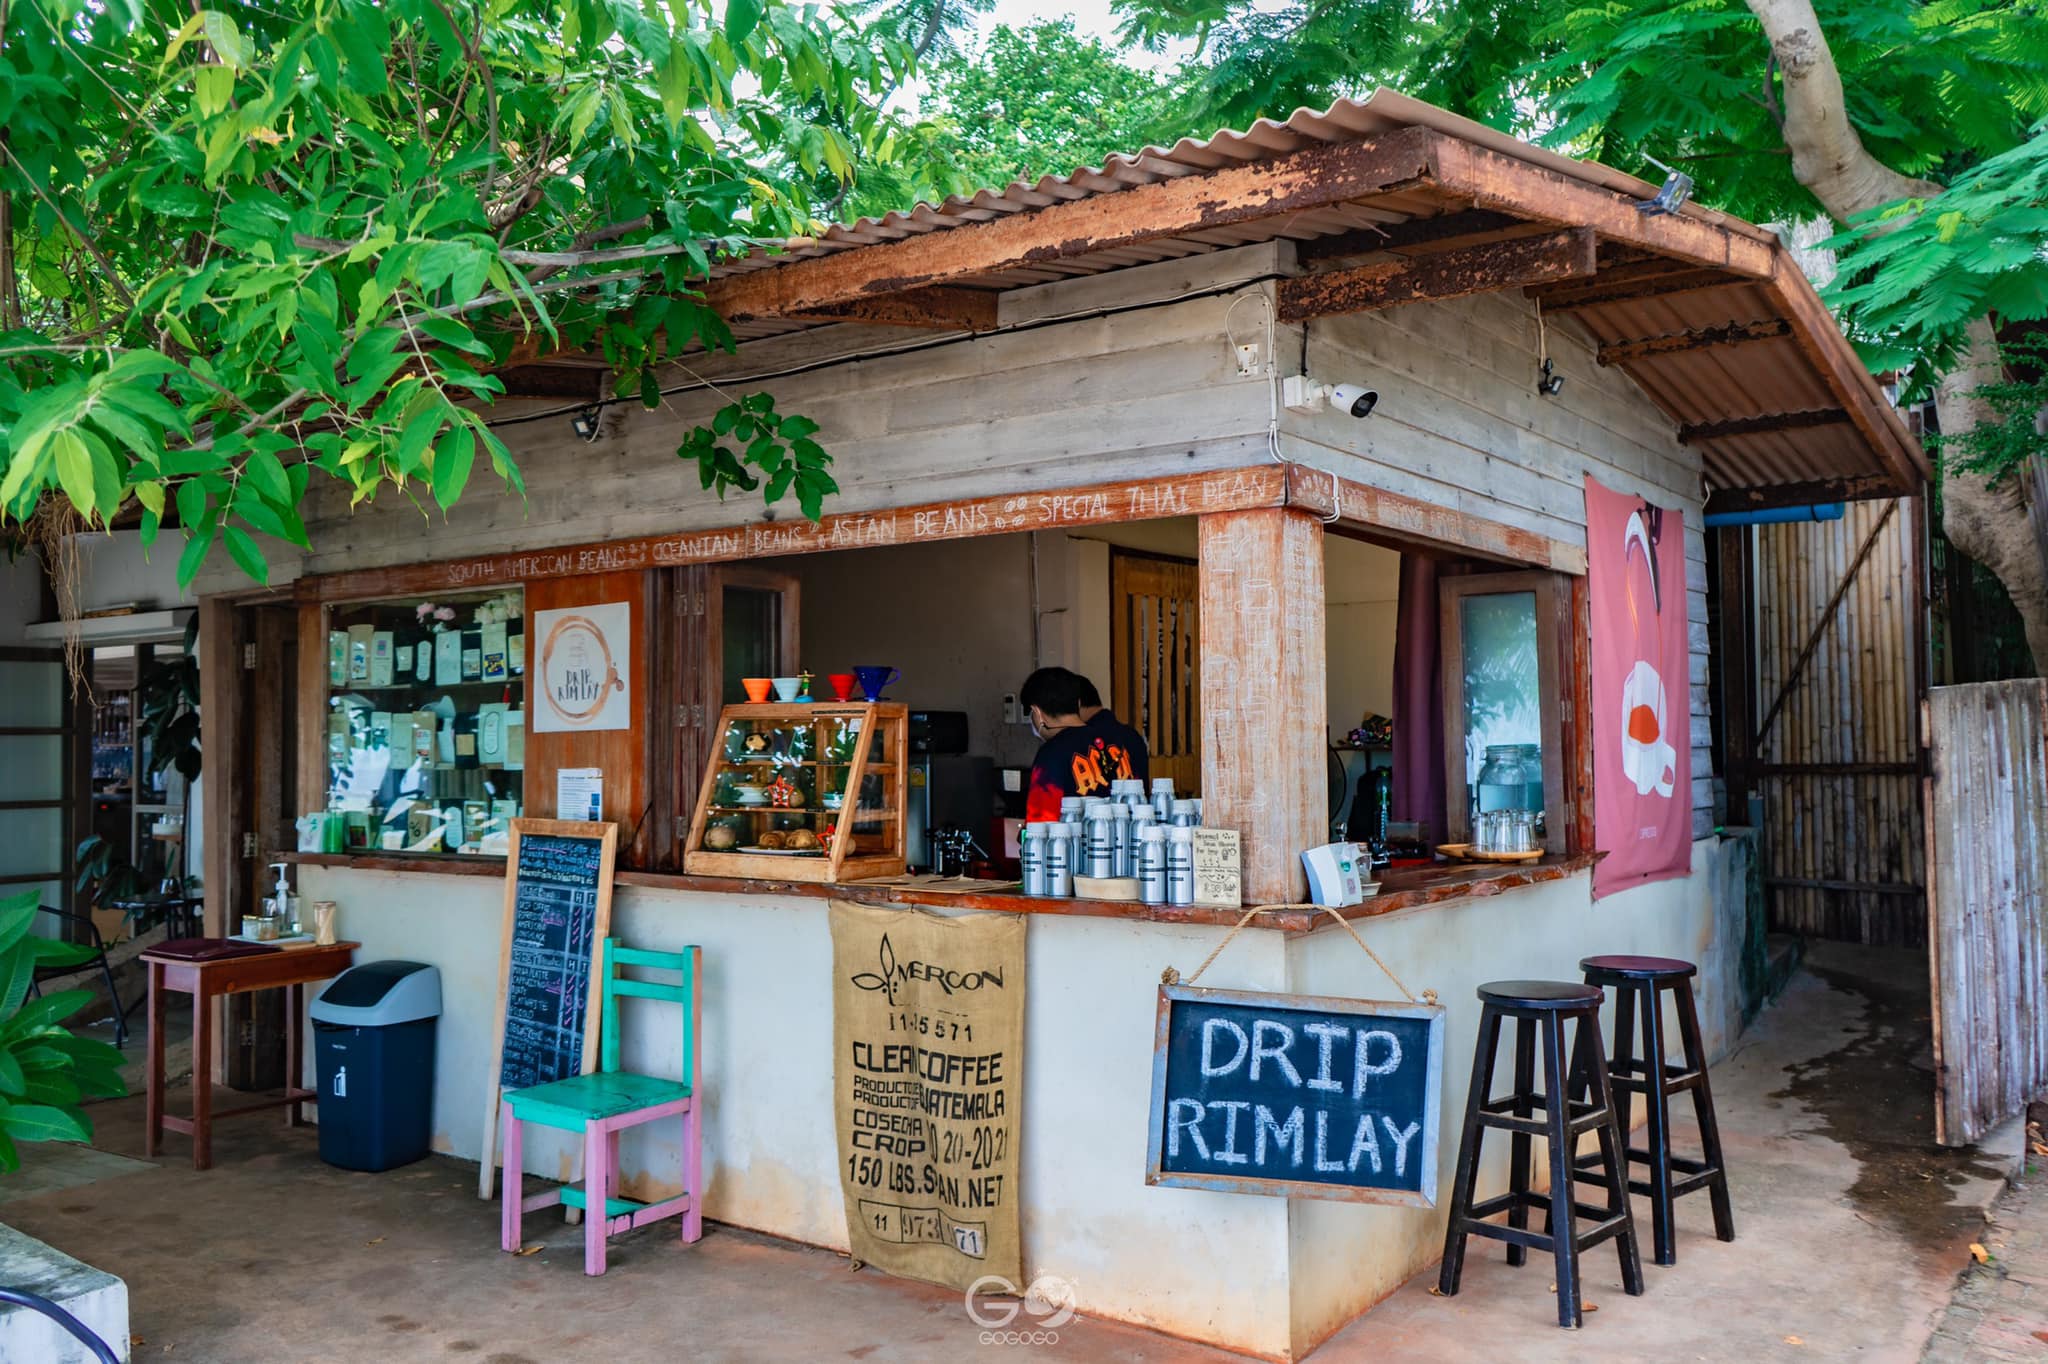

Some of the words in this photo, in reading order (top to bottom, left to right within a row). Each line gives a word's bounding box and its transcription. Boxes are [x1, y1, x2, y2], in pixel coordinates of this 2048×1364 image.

[1038, 493, 1112, 522] SPECIAL
[1125, 484, 1192, 514] THAI
[755, 527, 801, 550] BEANS
[832, 515, 896, 544] ASIAN
[914, 504, 987, 537] BEANS
[448, 563, 495, 583] SOUTH
[504, 554, 572, 578] AMERICAN
[579, 546, 626, 571] BEANS
[897, 960, 1004, 995] MERCON
[918, 1047, 1003, 1086] COFFEE
[1201, 1018, 1402, 1100] DRIP
[853, 1108, 922, 1137] COSECHA
[1168, 1098, 1421, 1177] RIMLAY
[852, 1130, 926, 1158] CROP
[848, 1154, 883, 1188] 150
